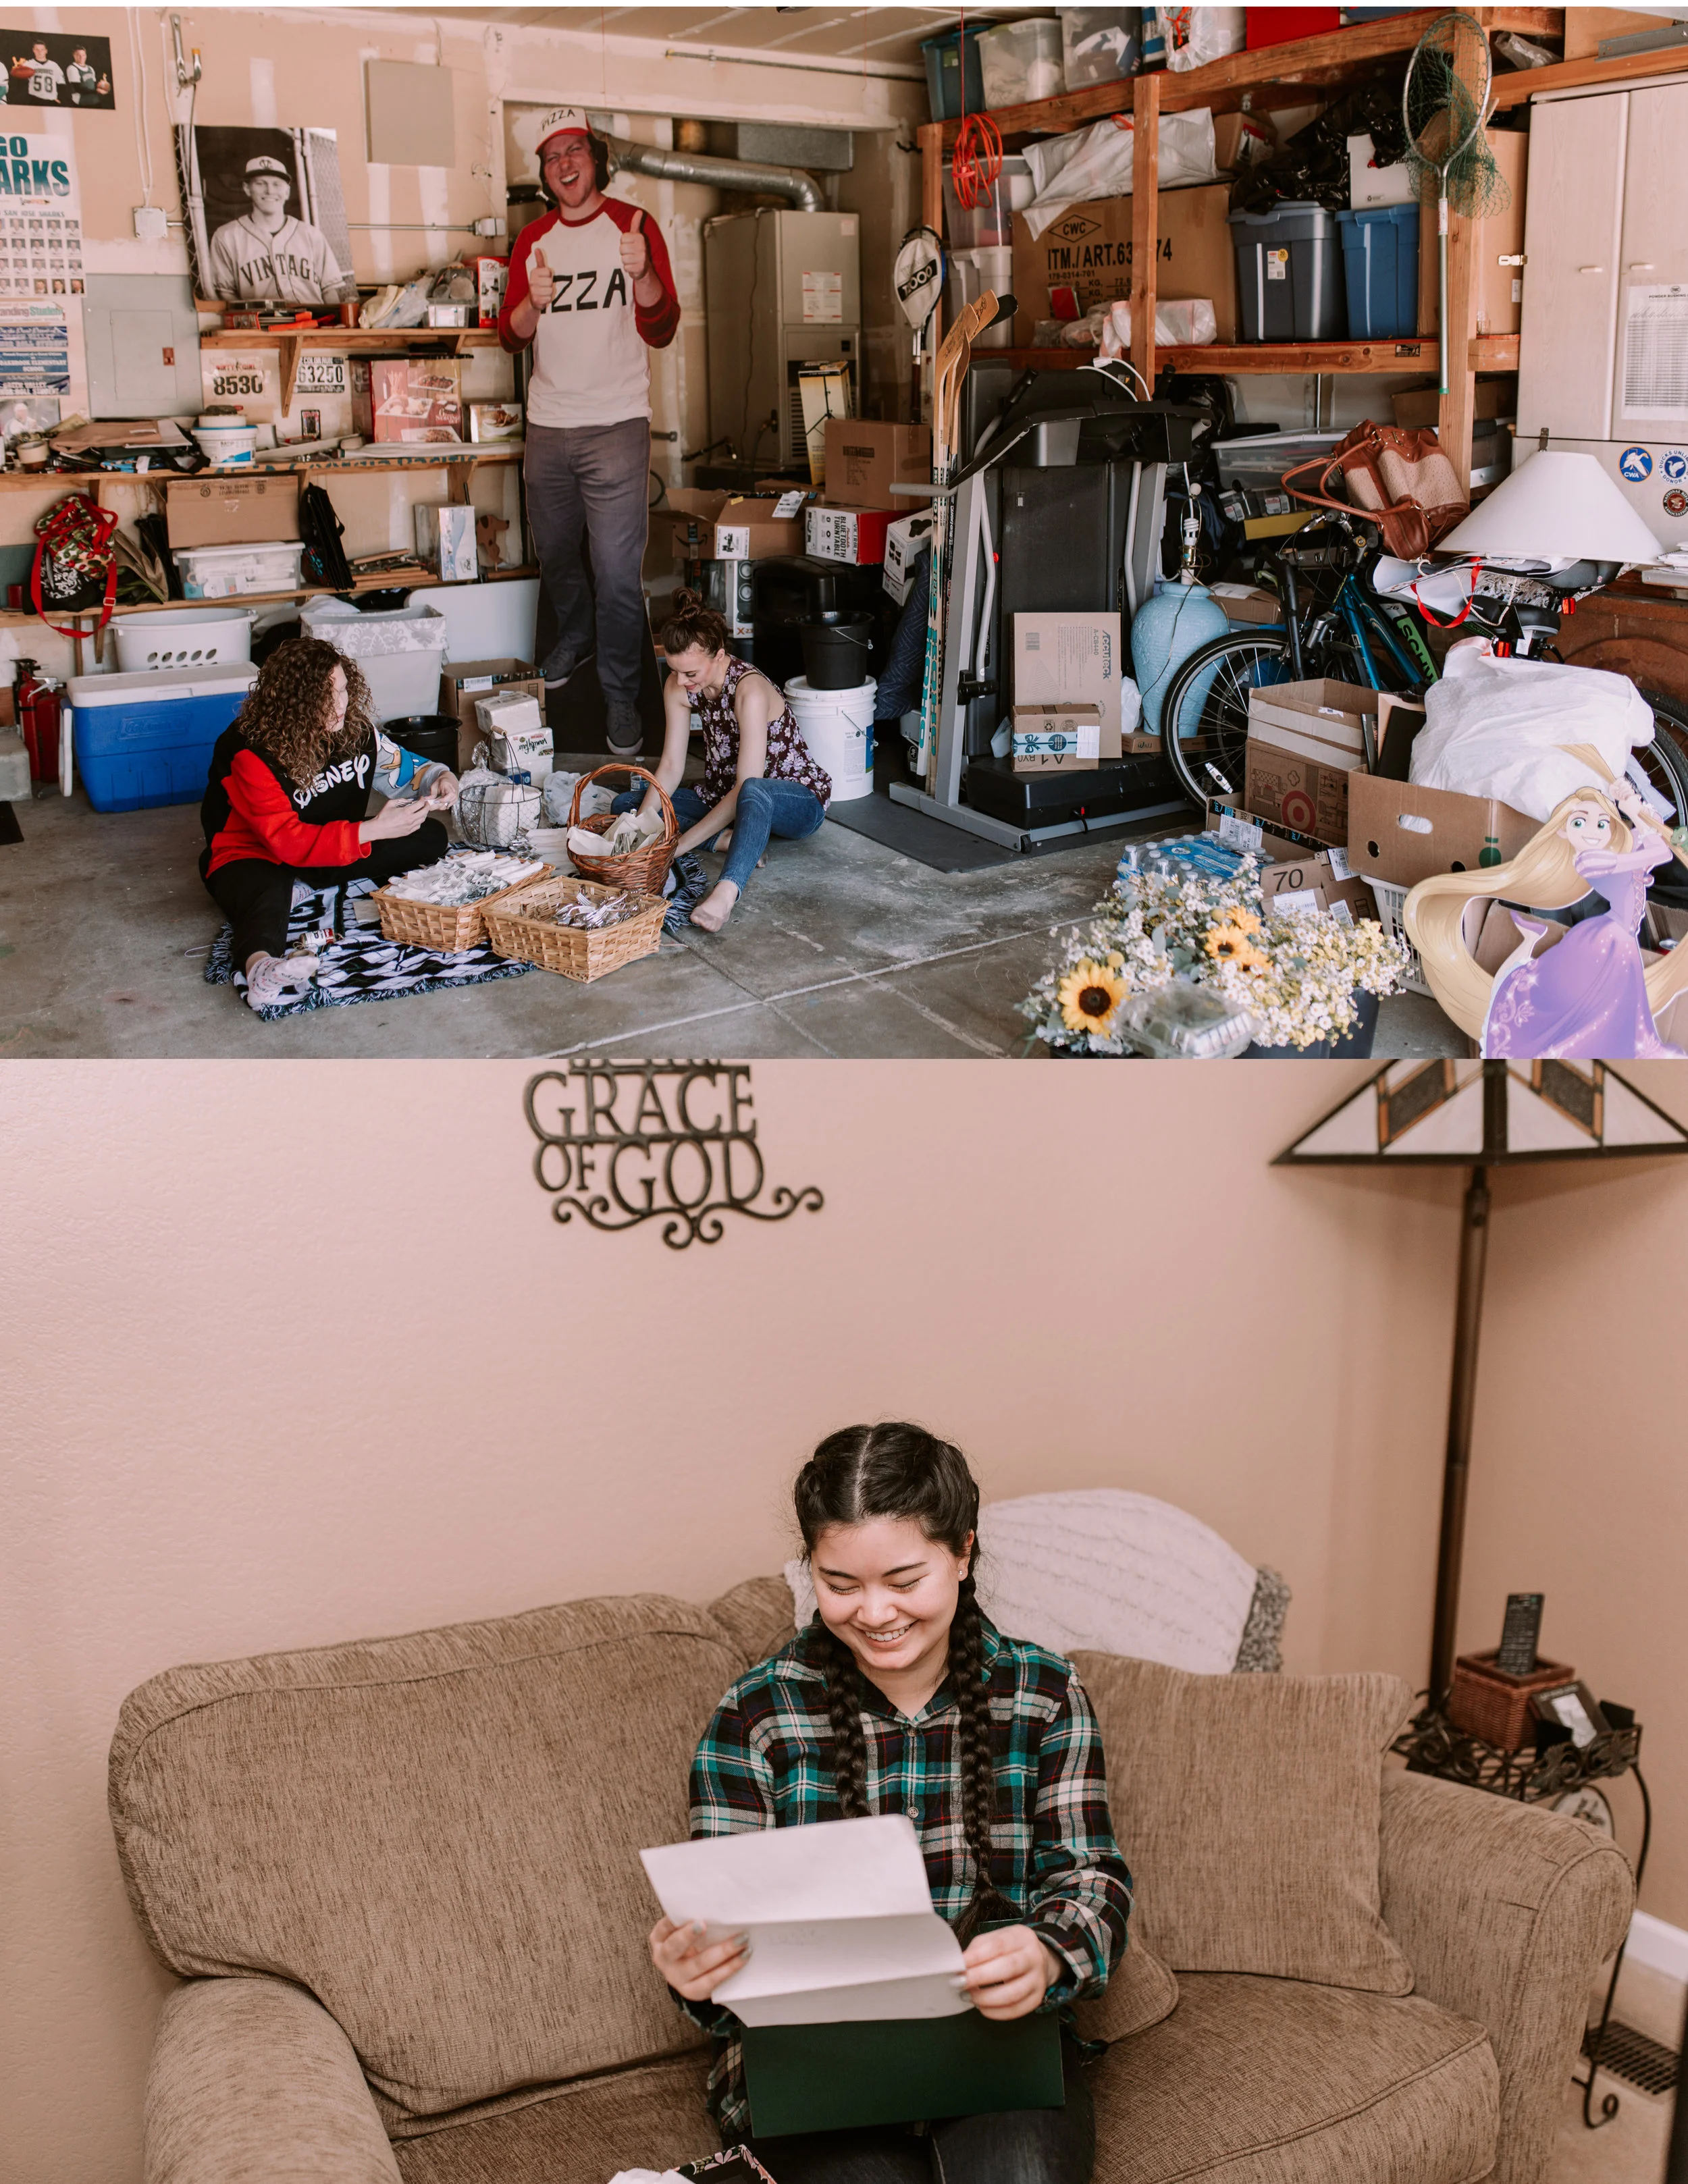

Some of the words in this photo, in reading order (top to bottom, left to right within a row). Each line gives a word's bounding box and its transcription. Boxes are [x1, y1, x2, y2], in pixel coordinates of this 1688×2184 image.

[34, 76, 53, 92] 58
[542, 109, 575, 131] PIZZA
[1063, 222, 1086, 236] CWC
[298, 365, 343, 383] 63250
[1662, 475, 1683, 484] DONOR
[293, 754, 370, 809] DISNEY
[1273, 868, 1303, 892] 70
[523, 1065, 757, 1141] GRACE
[534, 1141, 596, 1192] OF
[610, 1138, 764, 1215] GOD
